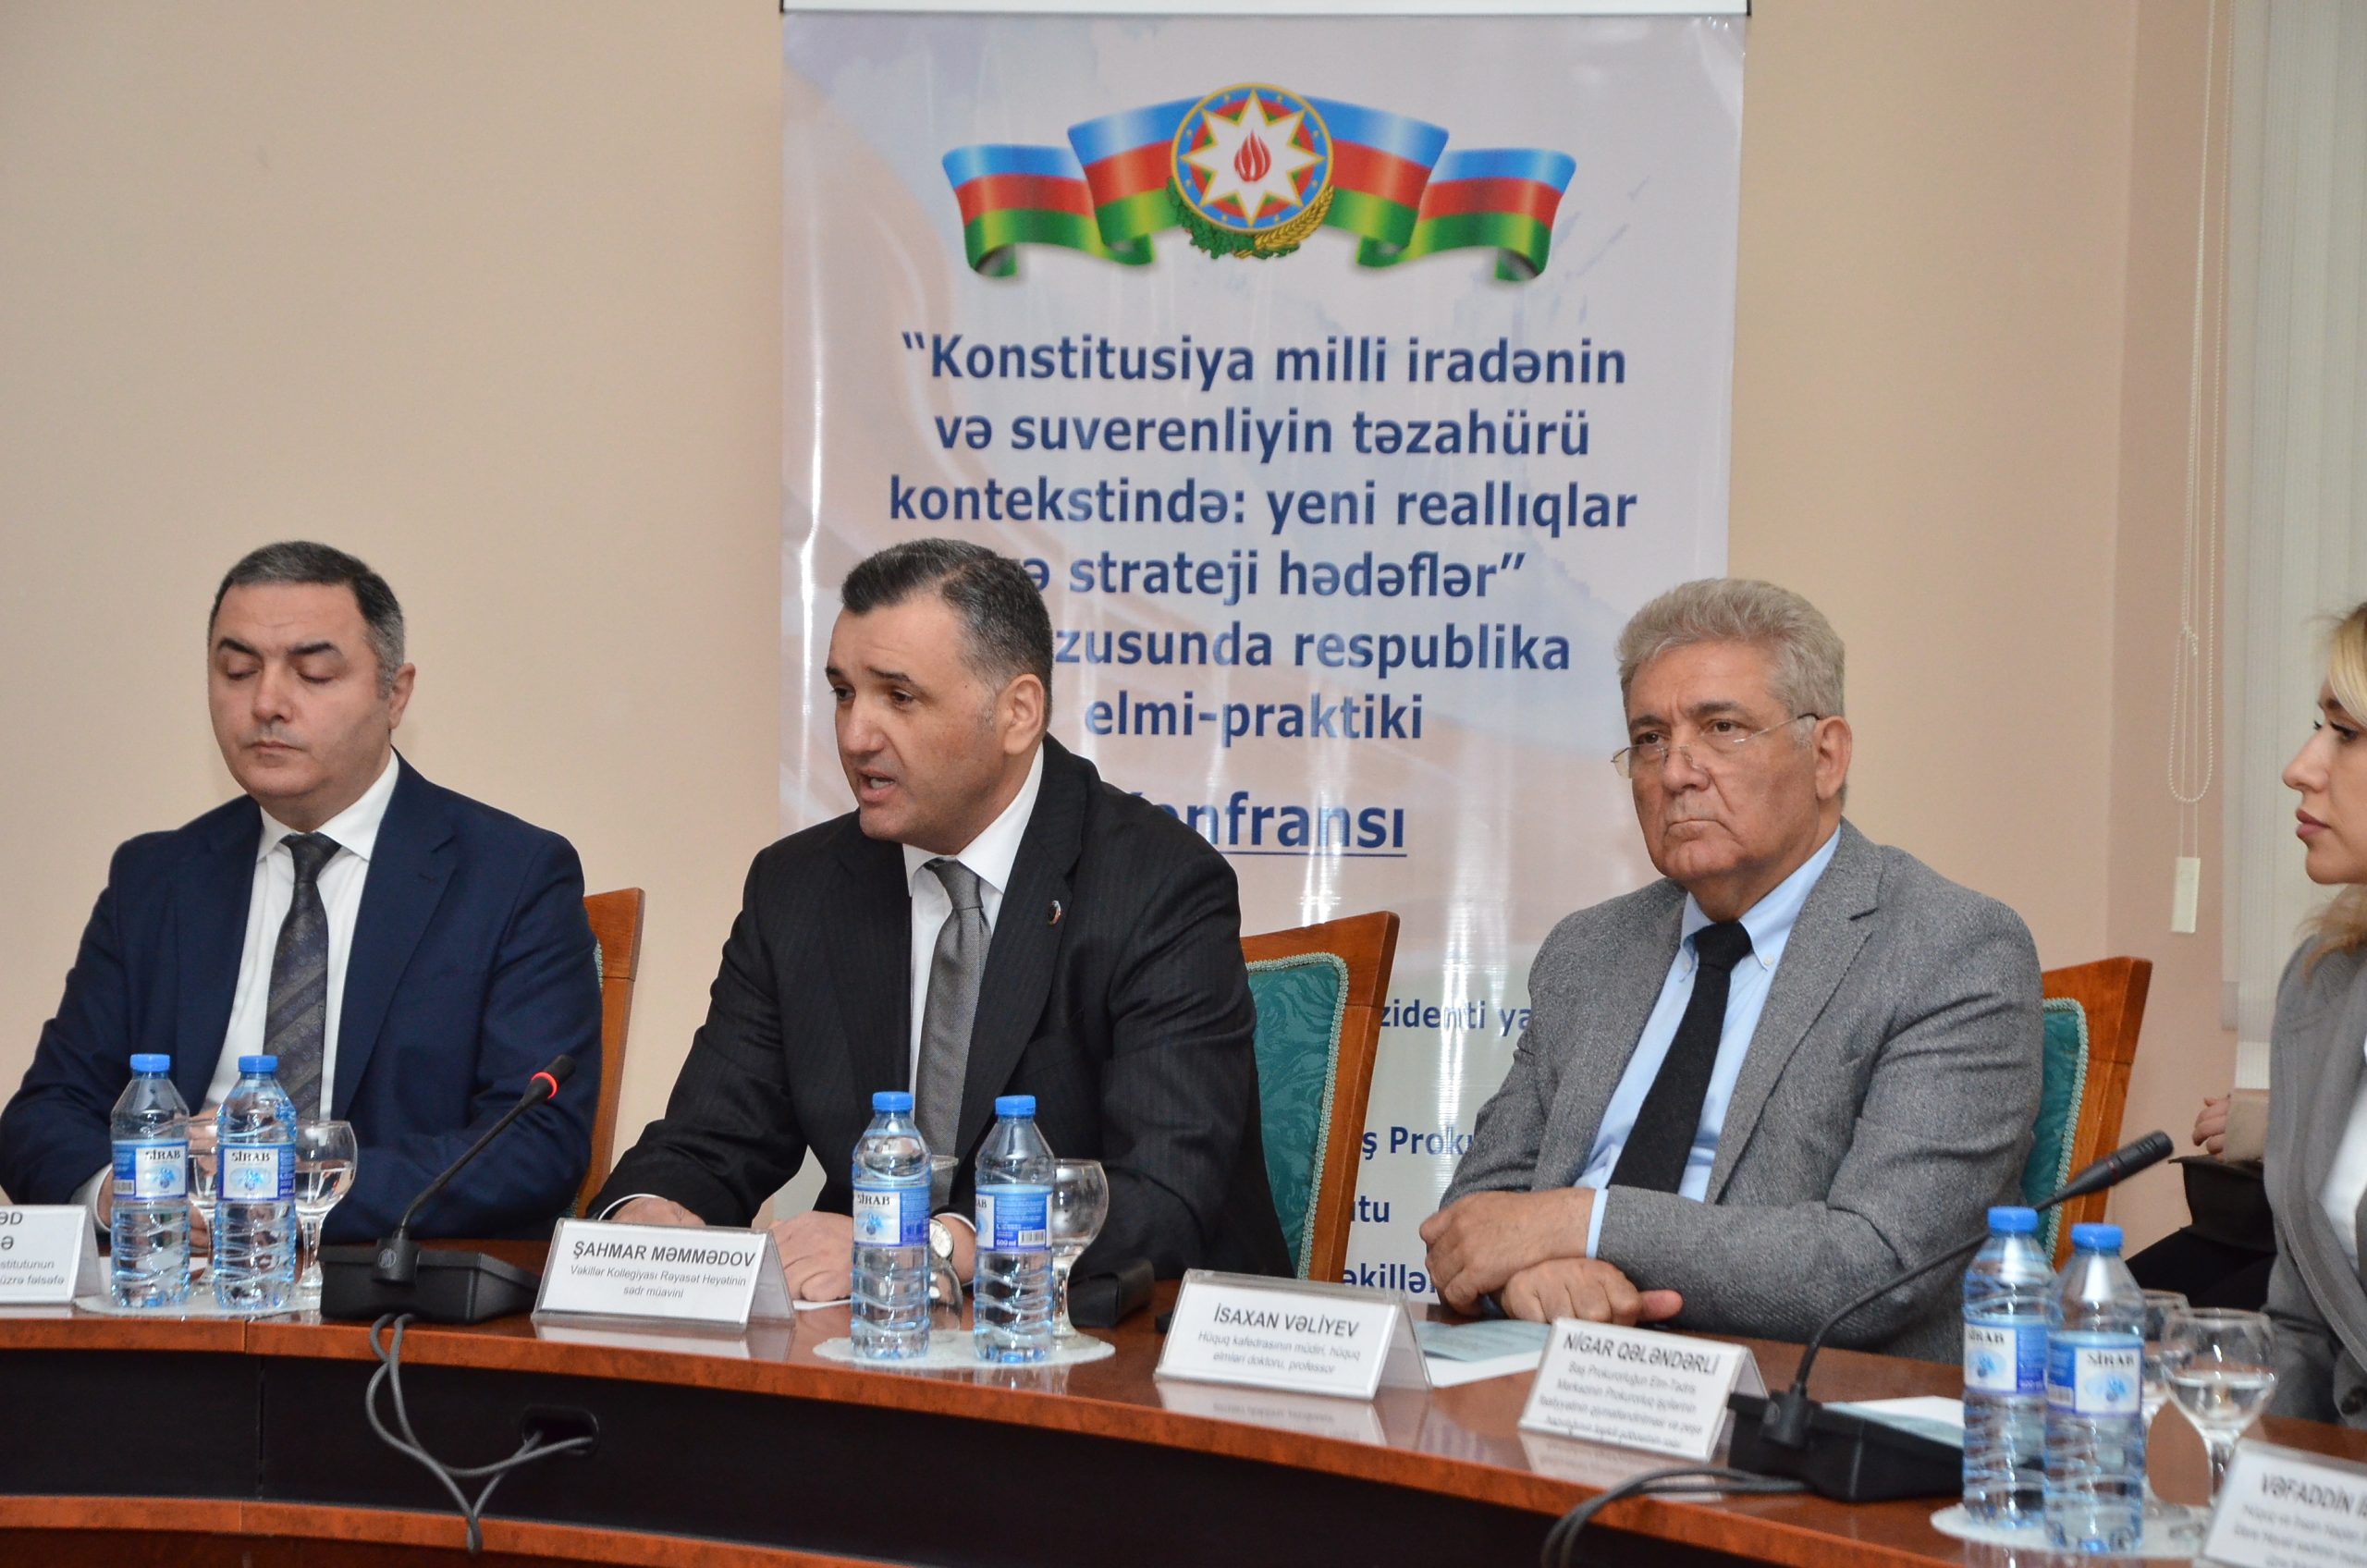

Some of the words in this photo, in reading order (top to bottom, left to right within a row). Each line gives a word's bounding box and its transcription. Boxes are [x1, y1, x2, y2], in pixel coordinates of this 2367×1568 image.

[1276, 337, 1387, 382] milli
[1408, 337, 1626, 384] iradənin
[935, 414, 993, 450] və
[1011, 407, 1332, 463] suverenliyin
[1353, 409, 1589, 456] təzahürü
[889, 474, 1245, 524] kontekstində:
[1266, 479, 1376, 535] yeni
[1397, 480, 1638, 539] reallıqlar
[1023, 557, 1050, 593] ə
[1069, 549, 1258, 606] strateji
[1055, 620, 1272, 667] zusunda
[1294, 622, 1571, 680] respublika
[1085, 689, 1423, 748] elmi-praktiki
[1380, 998, 1486, 1029] zidenti
[1501, 1007, 1532, 1037] ya
[1390, 1126, 1474, 1156] Prok
[0, 1211, 23, 1226] ƏD
[0, 1260, 55, 1270] stitutunun
[573, 1241, 646, 1260] ŞAHMAR
[651, 1246, 756, 1268] MƏMMƏDOV
[570, 1264, 606, 1276] Vəkillər
[607, 1267, 658, 1281] Kollegiyası
[660, 1270, 700, 1284] Rəyasət
[702, 1273, 747, 1287] Heyətinin
[623, 1286, 644, 1296] sədr
[646, 1288, 684, 1299] müavini
[1214, 1303, 1280, 1329] İSAXAN
[1284, 1314, 1359, 1339] VƏLİYEV
[1563, 1331, 1615, 1357] NİGAR
[1616, 1341, 1721, 1376] QƏLƏNDƏRLİ
